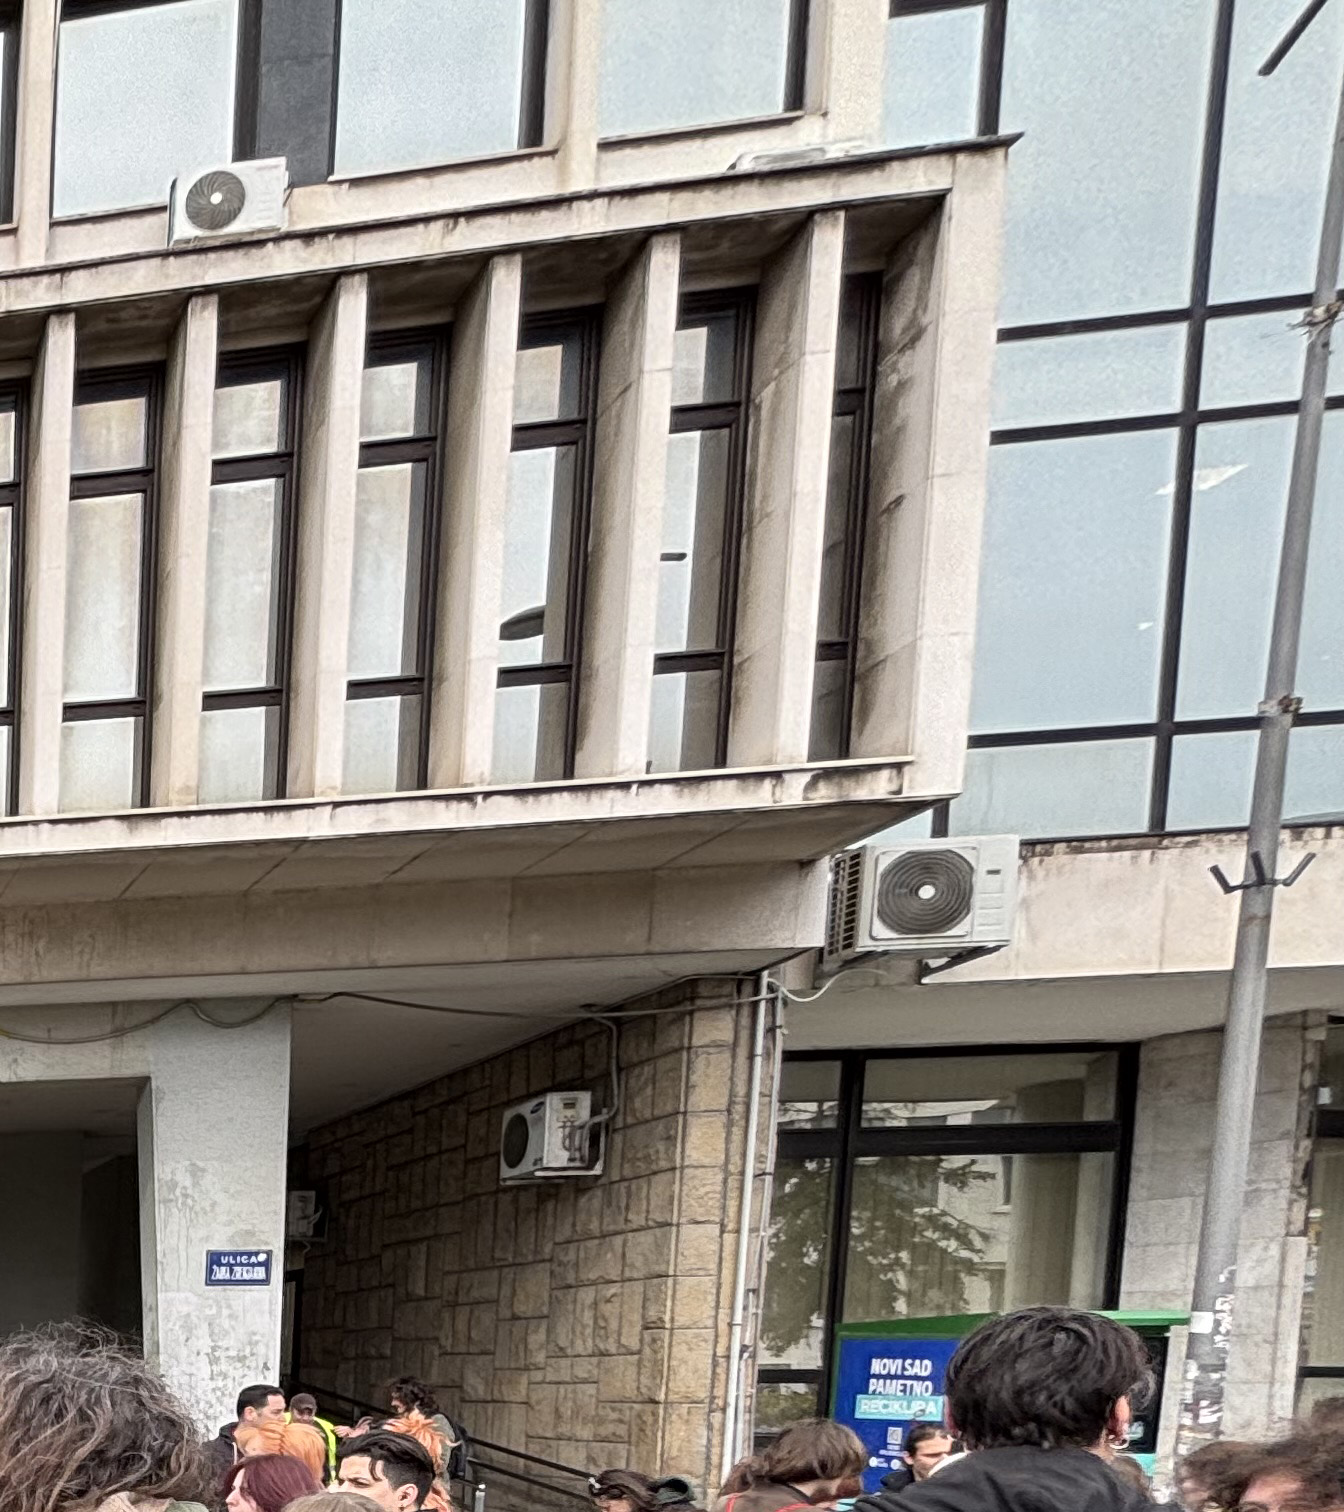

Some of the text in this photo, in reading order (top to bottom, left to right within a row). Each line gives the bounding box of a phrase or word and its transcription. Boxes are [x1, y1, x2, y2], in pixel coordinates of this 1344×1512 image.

[220, 1255, 258, 1264] ULICA
[870, 1358, 932, 1377] NOVI SAD
[868, 1378, 933, 1397] PAMETNO
